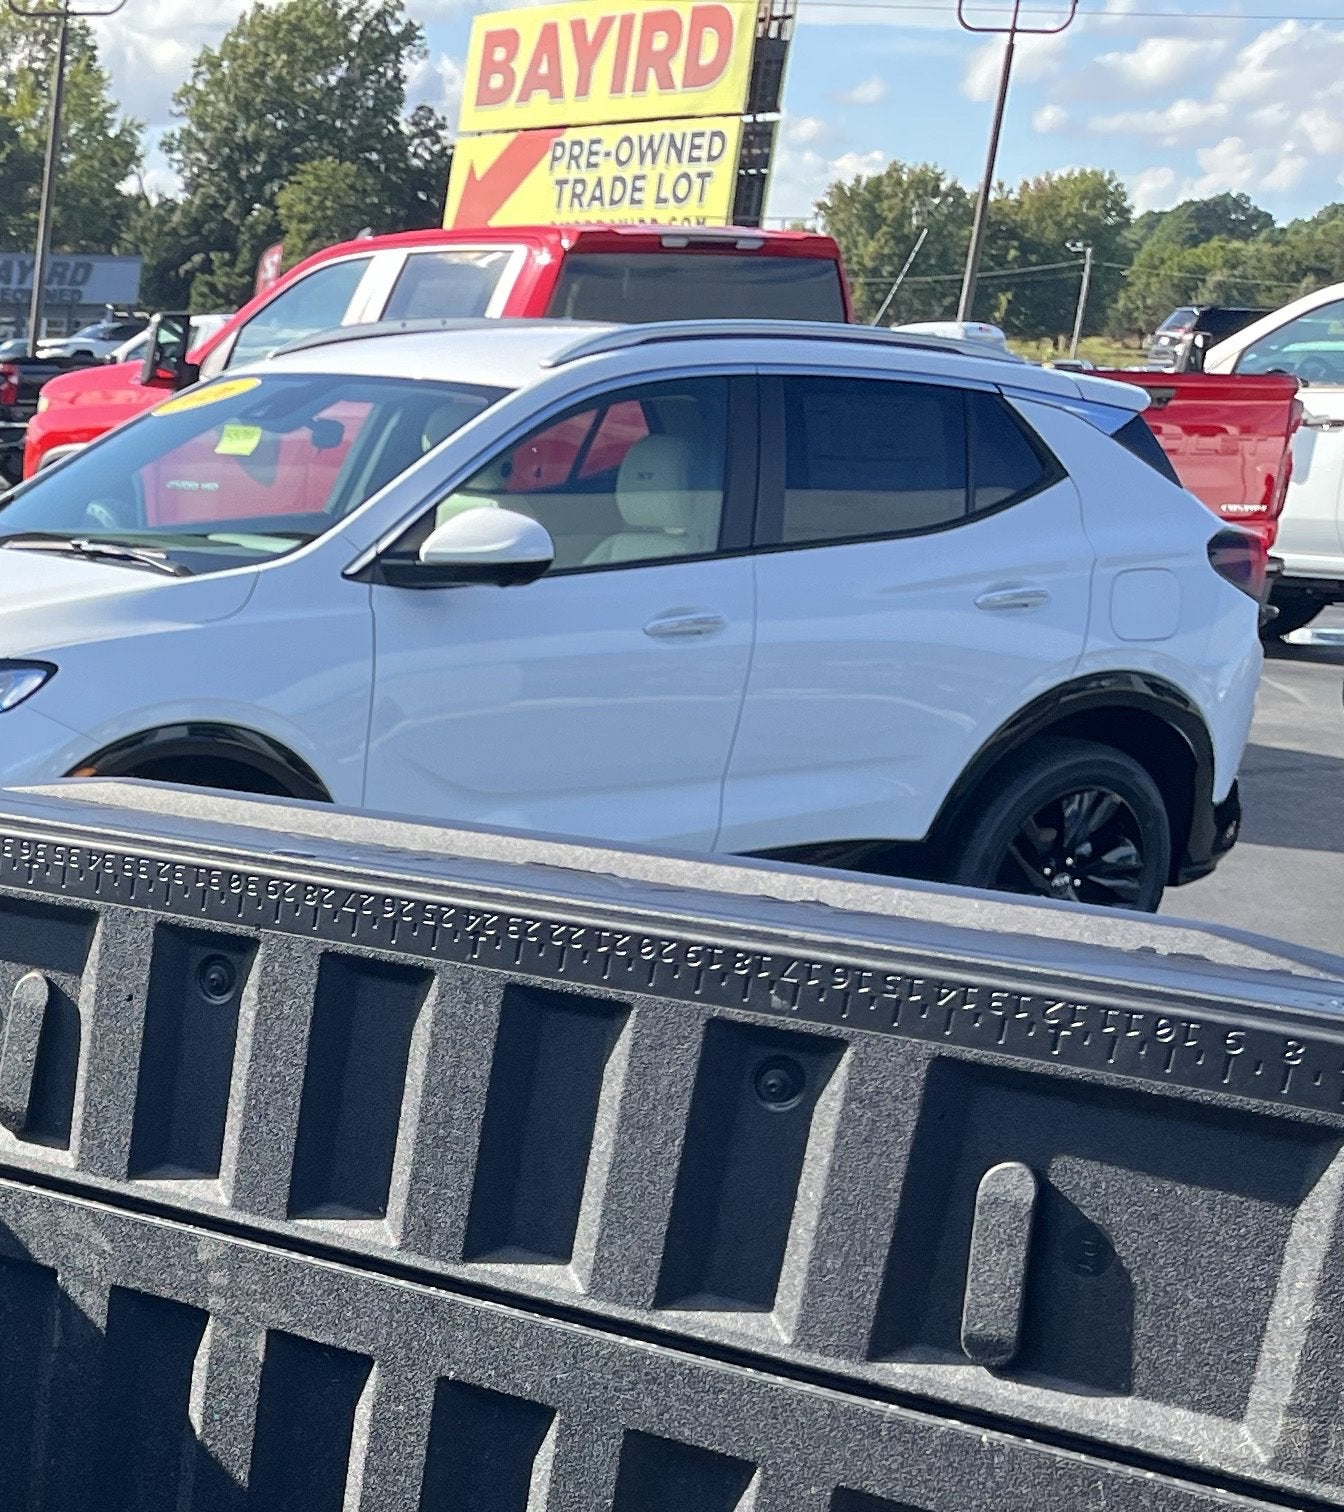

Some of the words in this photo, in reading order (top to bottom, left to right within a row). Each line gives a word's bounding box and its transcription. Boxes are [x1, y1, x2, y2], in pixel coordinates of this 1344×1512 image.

[474, 4, 733, 107] BAYIRD
[549, 130, 726, 172] PRE-OWNED
[554, 174, 647, 210] TRADE
[655, 171, 713, 206] LOT
[20, 841, 47, 863] 36
[53, 846, 80, 868] 35
[87, 853, 115, 874] 34
[123, 857, 150, 879] 33
[157, 862, 186, 885] 32
[193, 868, 222, 890] 31
[230, 874, 259, 896] 30
[267, 880, 297, 902] 29
[305, 886, 335, 908] 28
[341, 893, 375, 915] 27
[383, 899, 415, 921] 26
[423, 905, 455, 928] 25
[463, 912, 498, 935] 24
[508, 917, 541, 941] 23
[550, 924, 586, 948] 22
[595, 931, 631, 956] 21
[640, 938, 677, 963] 20
[687, 946, 723, 970] 19
[734, 952, 772, 977] 18
[780, 960, 822, 985] 17
[832, 968, 872, 993] 16
[882, 976, 924, 1001] 15
[934, 987, 979, 1009] 14
[990, 992, 1031, 1018] 13
[1043, 1001, 1087, 1027] 12
[1100, 1009, 1144, 1037] 11
[1156, 1018, 1201, 1047] 10
[1225, 1030, 1246, 1055] 9
[1282, 1039, 1306, 1066] 8
